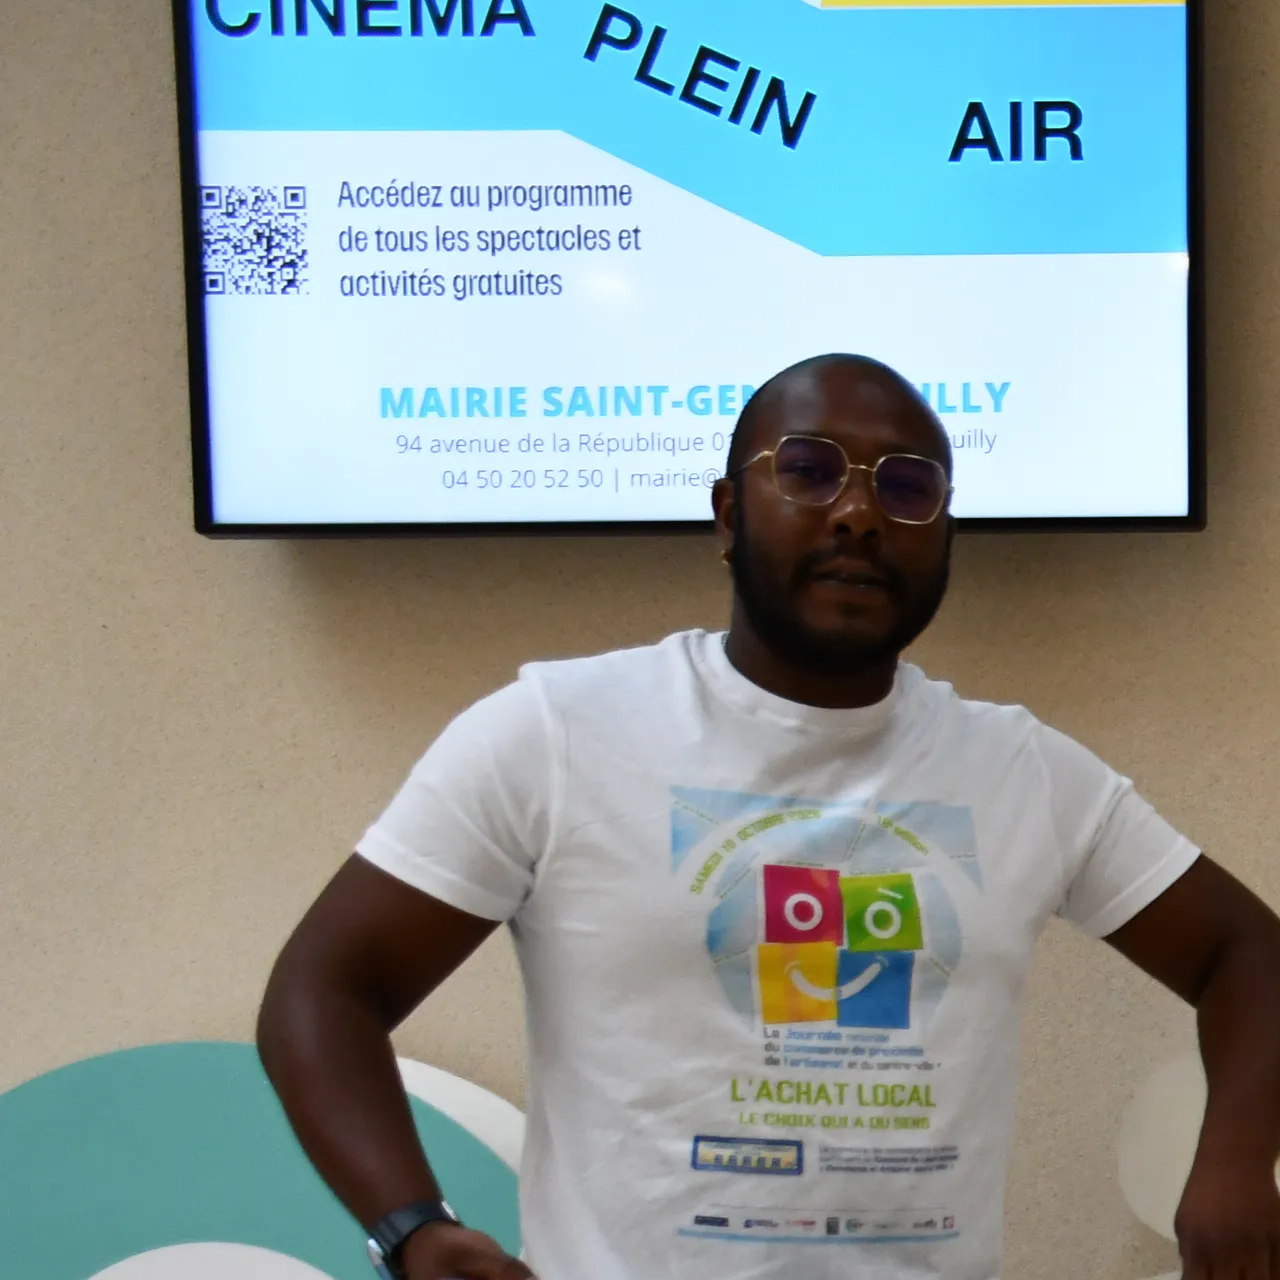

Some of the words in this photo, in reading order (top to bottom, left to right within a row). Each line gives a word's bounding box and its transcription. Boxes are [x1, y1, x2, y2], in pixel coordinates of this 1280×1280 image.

[583, 4, 817, 150] PLEIN
[948, 101, 1084, 162] AIR
[338, 179, 443, 208] Accédez
[450, 185, 480, 208] au
[487, 184, 632, 212] programme
[338, 225, 368, 252] de
[374, 227, 428, 252] tous
[436, 225, 469, 251] les
[476, 224, 611, 256] spectacles
[618, 226, 642, 250] et
[340, 268, 445, 297] activités
[453, 269, 563, 301] gratuites
[380, 386, 527, 418] MAIRIE
[396, 435, 421, 453] 94
[429, 437, 509, 454] avenue
[517, 433, 544, 453] de
[552, 433, 570, 452] la
[579, 431, 704, 457] République
[442, 470, 468, 489] 04
[477, 470, 503, 488] 50
[510, 470, 536, 488] 20
[544, 469, 569, 488] 52
[578, 469, 603, 488] 50
[730, 1078, 848, 1107] L'ACHAT
[856, 1082, 937, 1109] LOCAL
